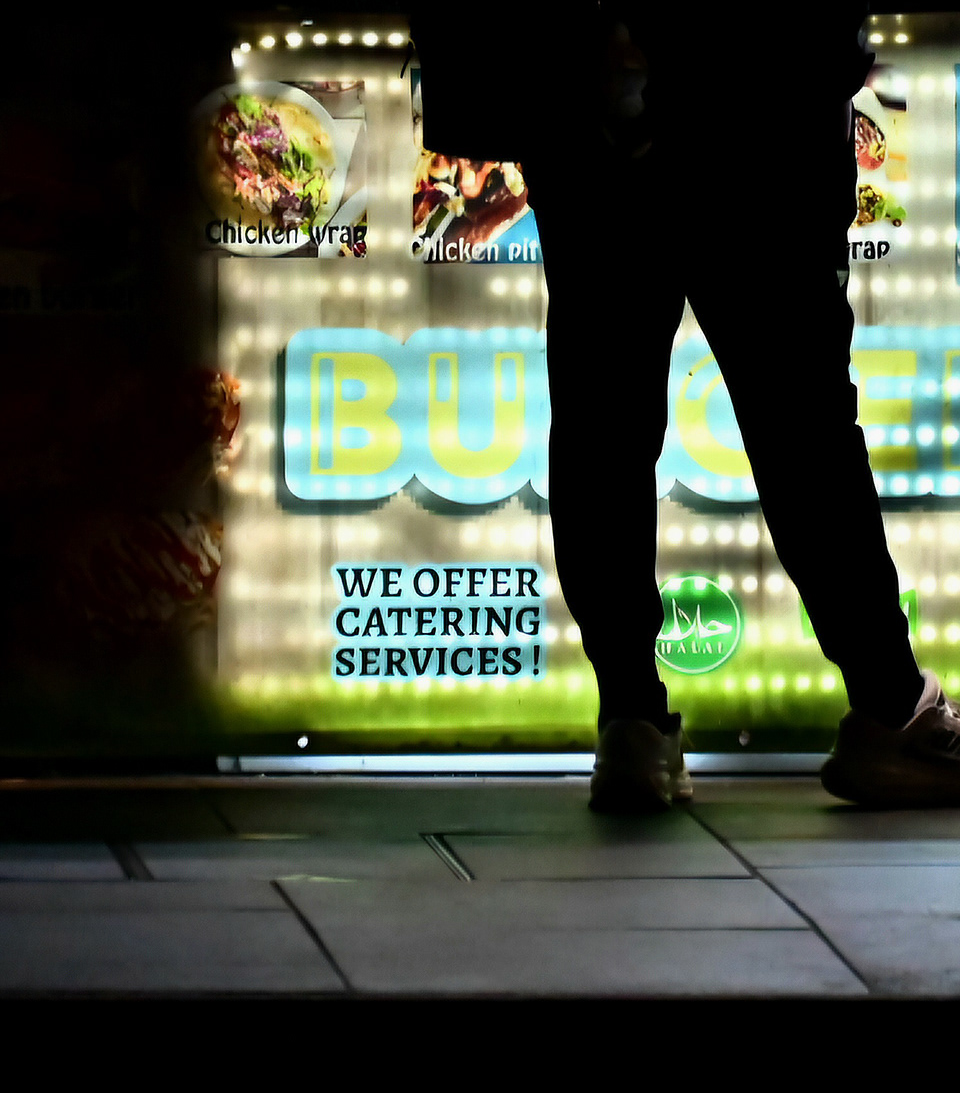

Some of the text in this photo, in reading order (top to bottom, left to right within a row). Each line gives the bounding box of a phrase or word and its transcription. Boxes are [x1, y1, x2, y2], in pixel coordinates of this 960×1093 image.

[205, 220, 299, 245] Chicken
[850, 240, 891, 260] rap
[337, 568, 540, 598] WE OFFER
[335, 606, 540, 637] CATERING
[335, 647, 521, 676] SERVICES
